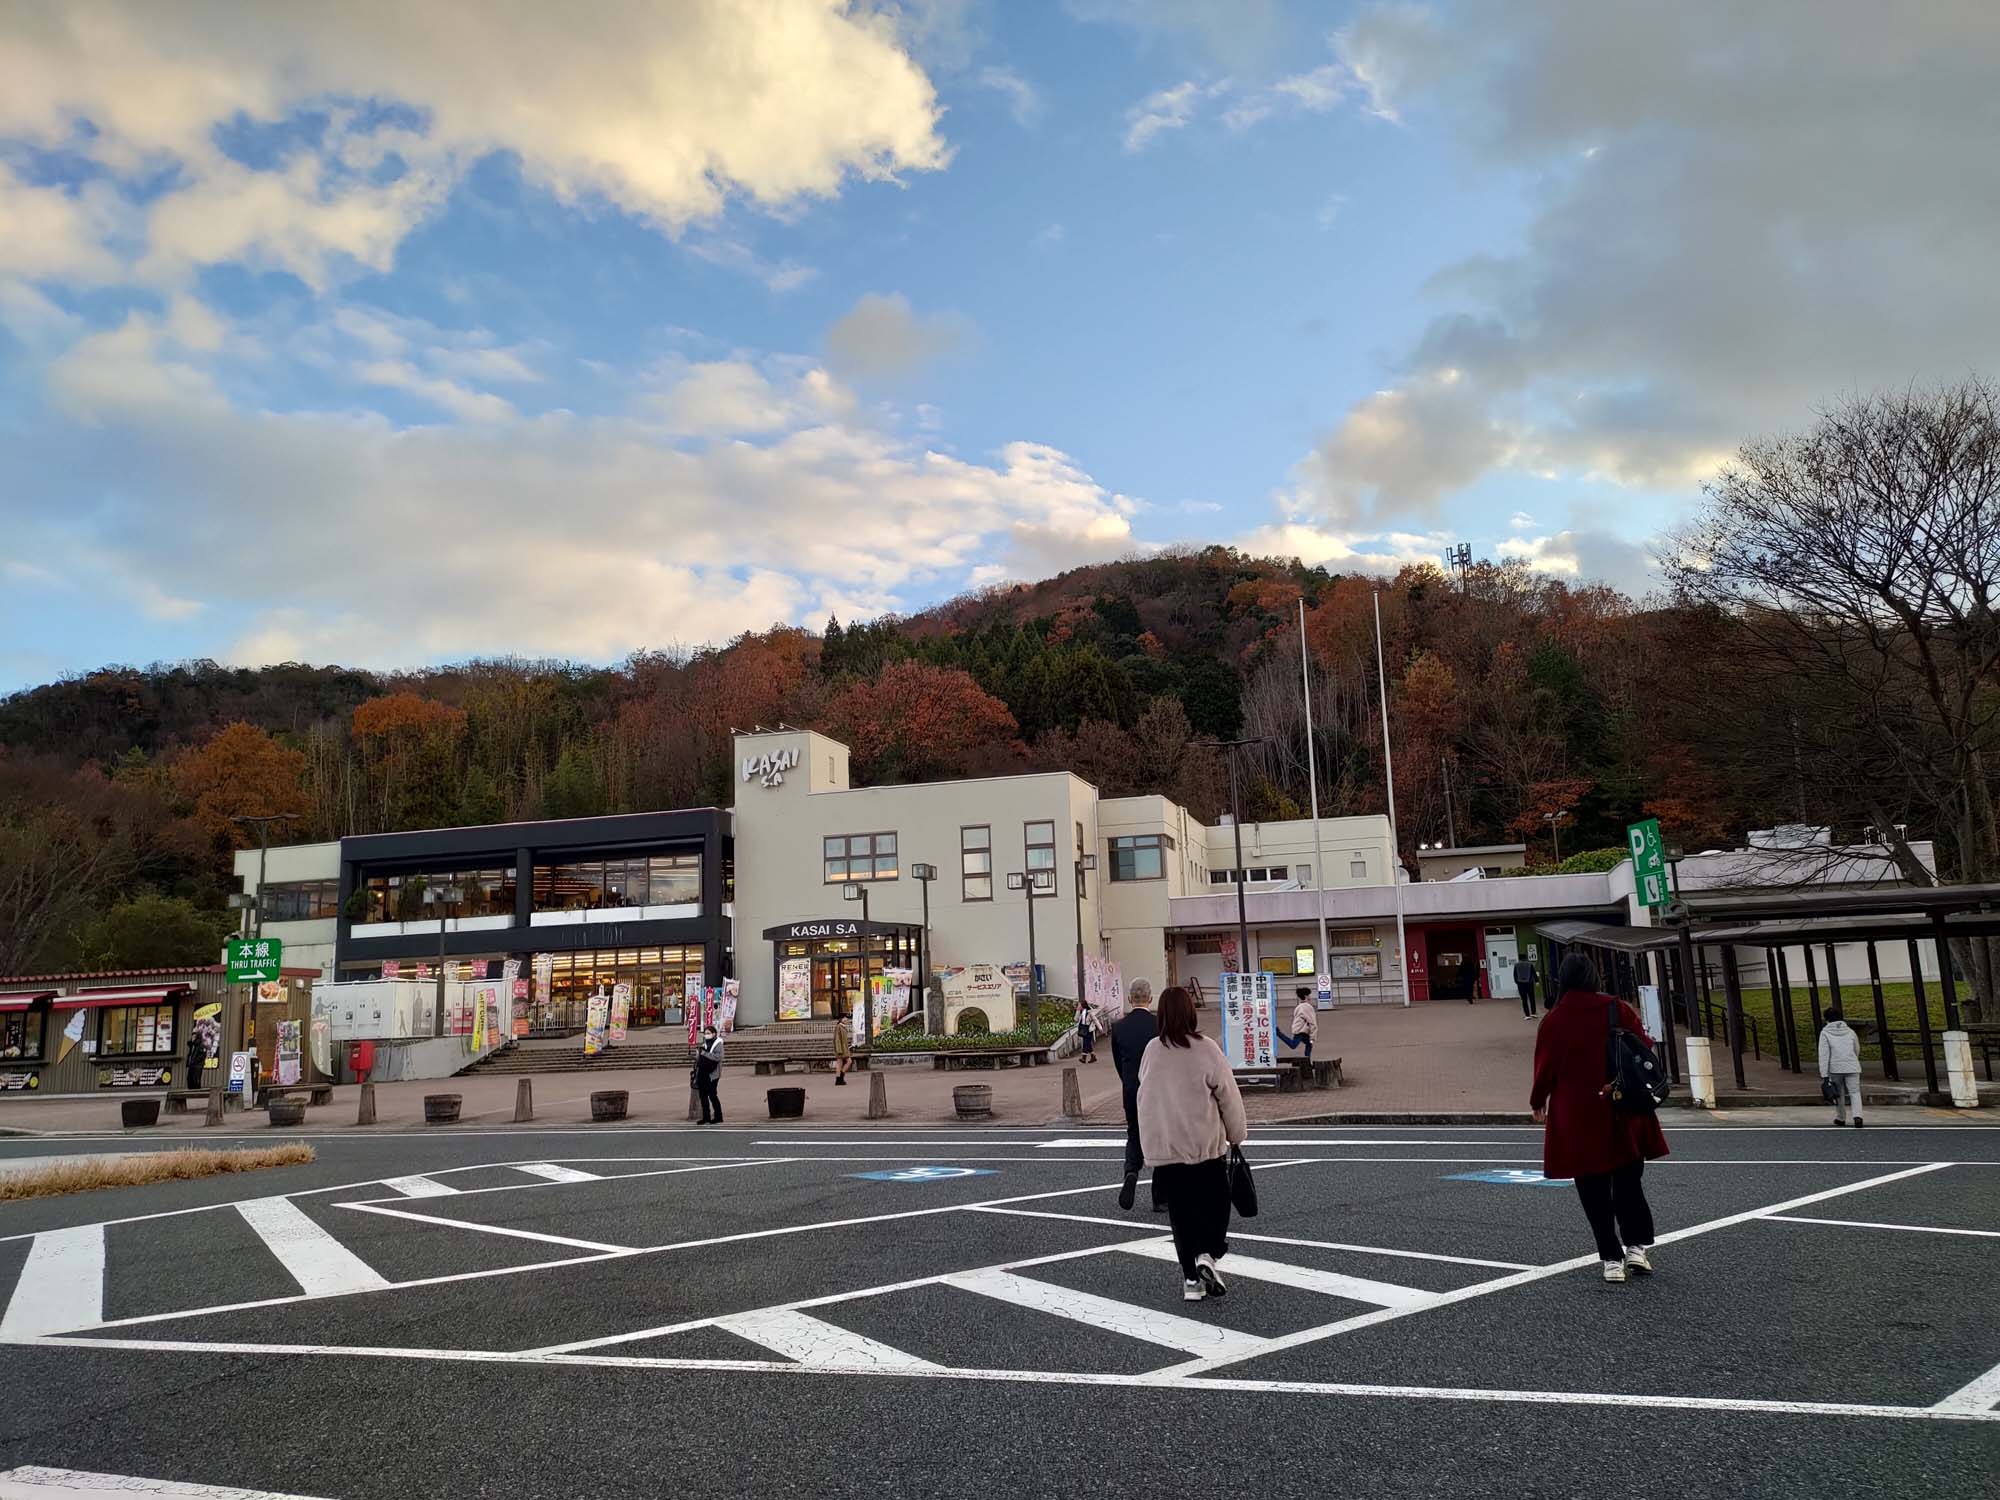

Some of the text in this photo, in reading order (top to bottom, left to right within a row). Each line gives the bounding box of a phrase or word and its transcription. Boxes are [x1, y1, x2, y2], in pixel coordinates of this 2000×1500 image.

[743, 747, 799, 782] KASAI
[761, 773, 782, 788] S.A
[1630, 829, 1645, 871] P
[791, 923, 857, 937] KASAI S.A
[239, 942, 269, 958] 本線
[231, 958, 277, 969] THRU TRAFFIC
[974, 974, 992, 983] かさい
[967, 983, 1001, 991] サービスエリア
[1227, 977, 1240, 1020] 実施します。
